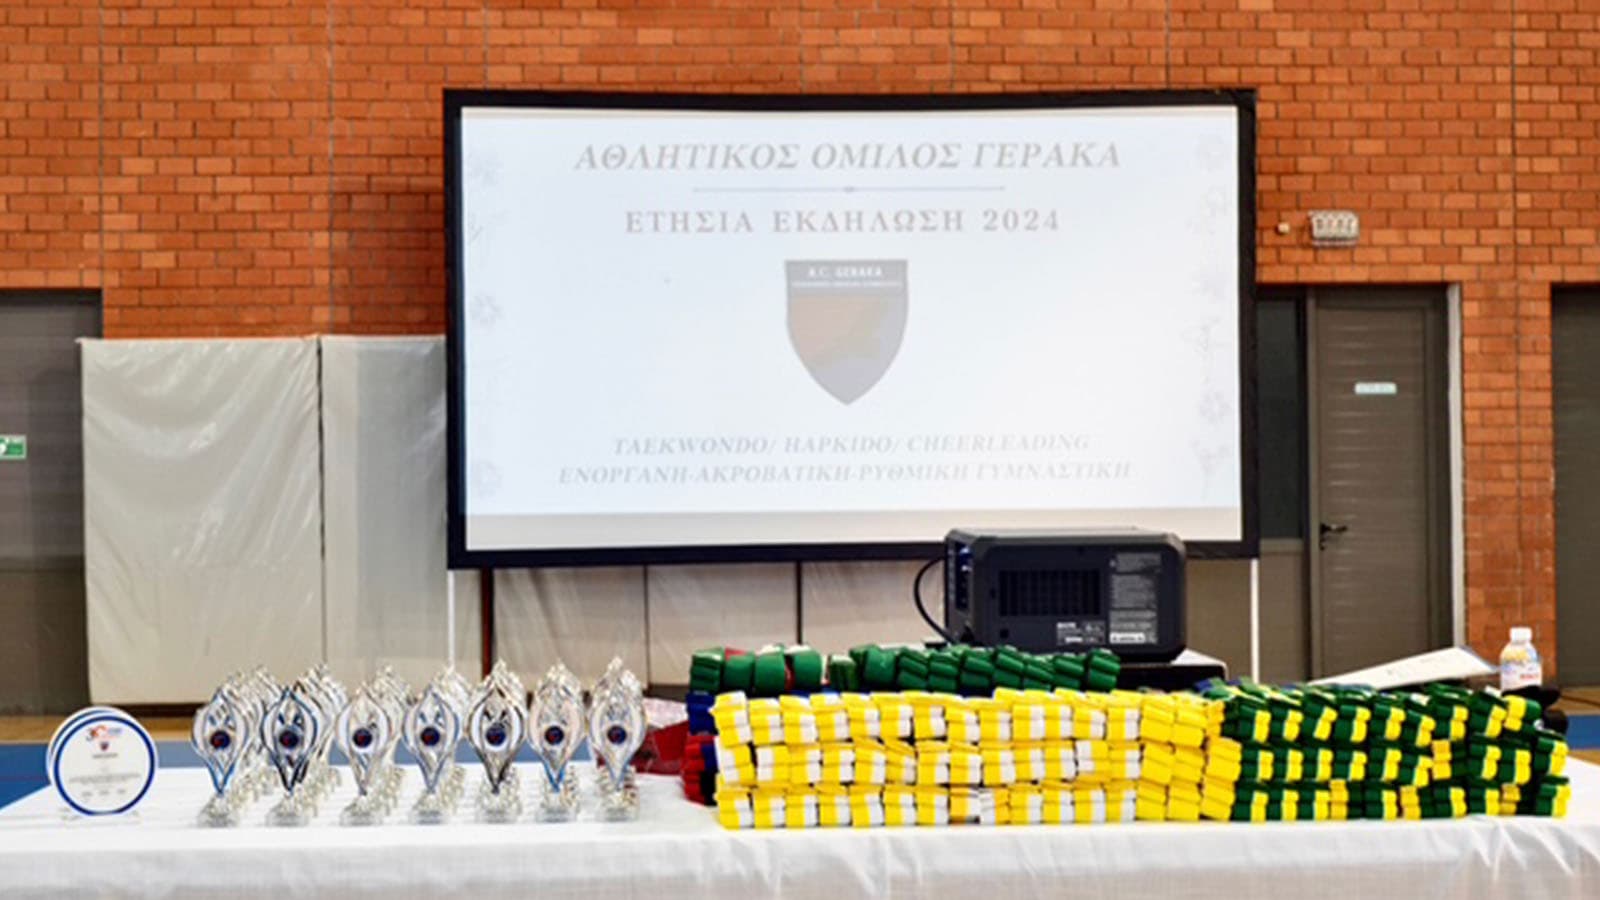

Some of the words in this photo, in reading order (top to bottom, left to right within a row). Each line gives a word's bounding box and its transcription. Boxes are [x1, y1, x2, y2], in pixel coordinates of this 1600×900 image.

[573, 143, 802, 172] ΑΘΛΗΤΙΚΟΣ
[809, 142, 963, 170] ΟΜΙΛΟΣ
[972, 142, 1122, 169] ΓΕΡΑΚΑ
[625, 210, 755, 235] ΕΤΗΣΙΑ
[772, 209, 964, 234] ΕΚΔΗΛΩΣΗ
[982, 208, 1060, 232] 2024
[905, 434, 1090, 453] CHEERLEADING
[975, 461, 1132, 480] ΓΥΜΝΑΣΤΙΚΗ
